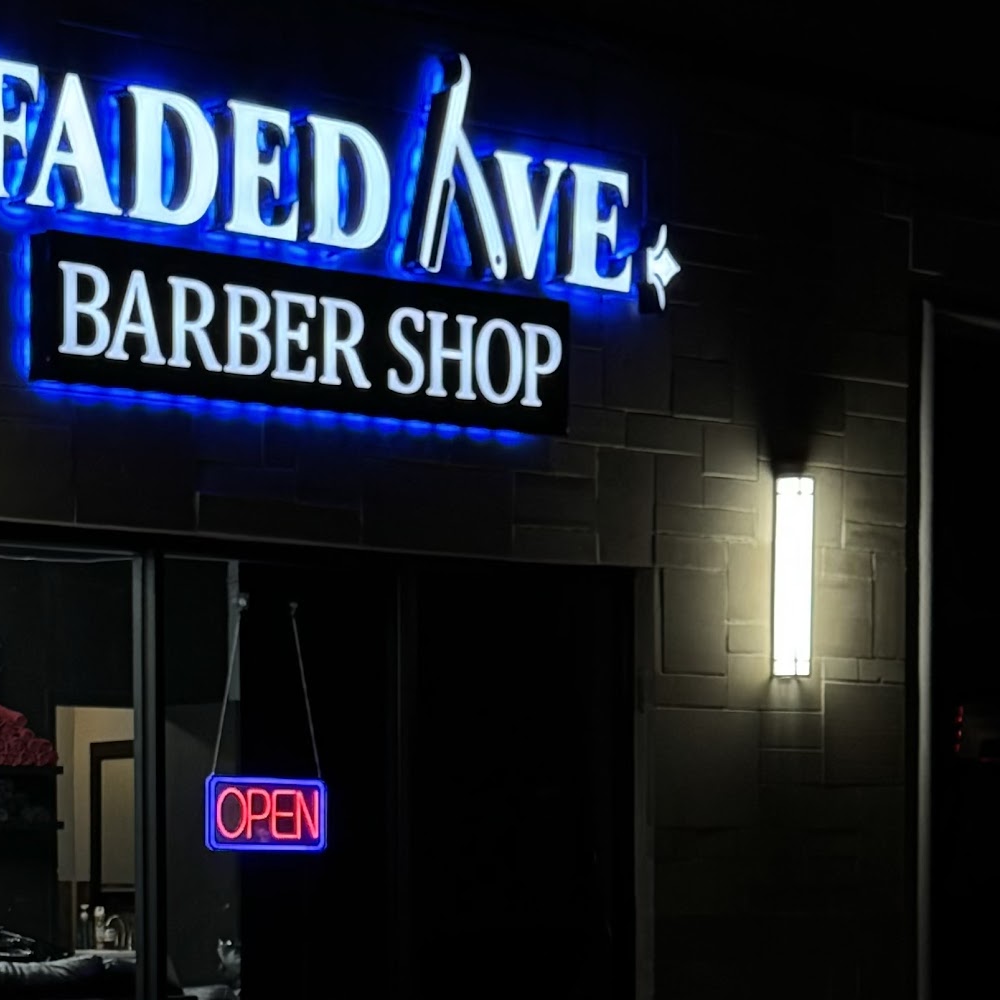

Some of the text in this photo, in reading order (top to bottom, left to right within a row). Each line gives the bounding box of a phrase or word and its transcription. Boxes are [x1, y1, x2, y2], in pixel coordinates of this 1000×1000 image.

[416, 53, 632, 292] AVE
[58, 260, 563, 408] BARBER SHOP
[216, 786, 319, 840] OPEN
